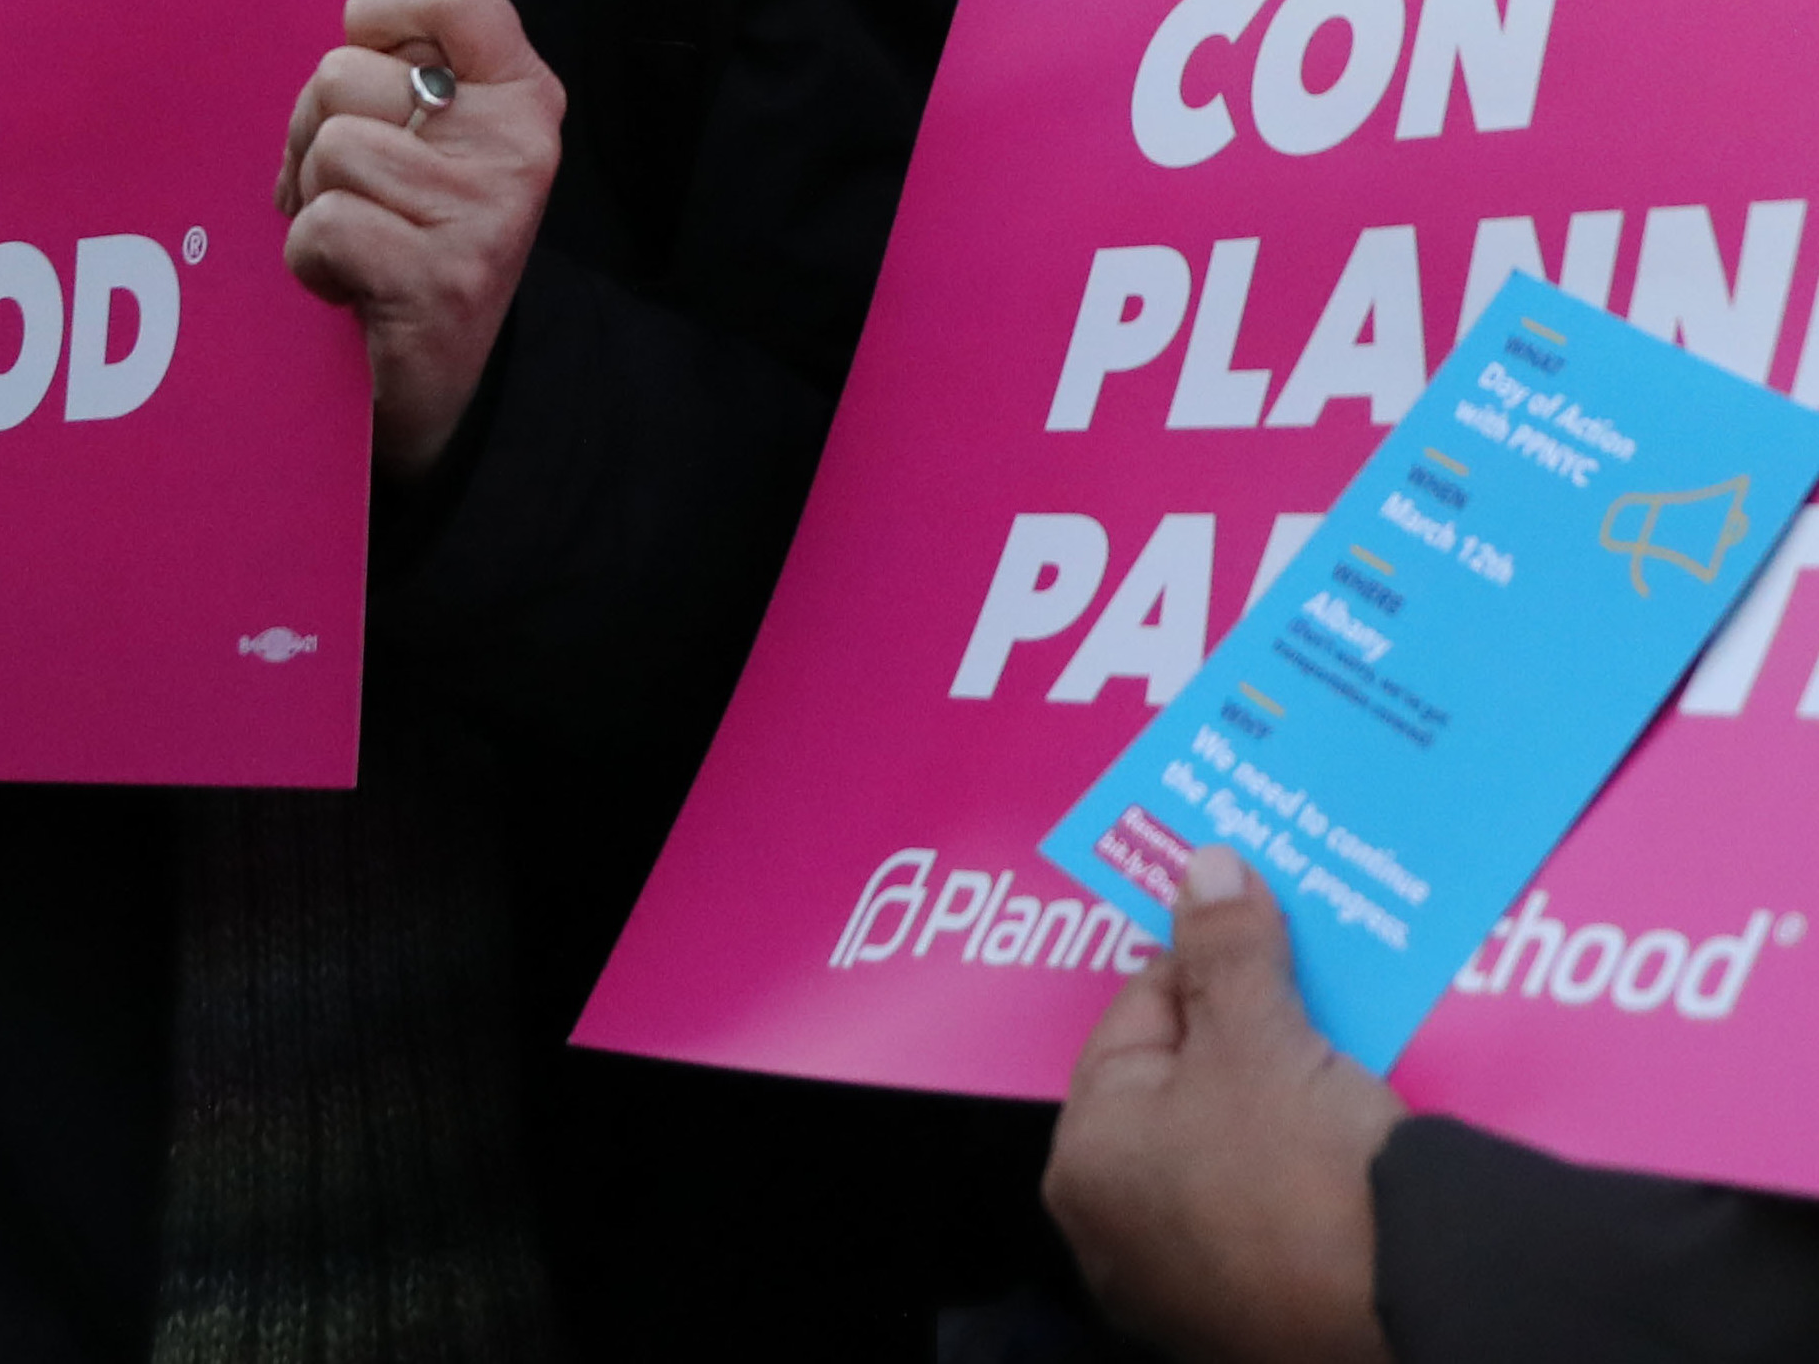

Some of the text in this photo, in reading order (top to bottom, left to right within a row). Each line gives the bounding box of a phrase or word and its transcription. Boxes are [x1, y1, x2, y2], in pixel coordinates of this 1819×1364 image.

[1455, 401, 1509, 441] with
[1478, 362, 1635, 459] Day of Action
[1381, 492, 1512, 583] March 12th
[1304, 592, 1390, 661] Albany
[1162, 761, 1207, 803] the
[1205, 789, 1270, 848] fight
[1266, 832, 1308, 873] for
[1192, 725, 1428, 903] We need to continue
